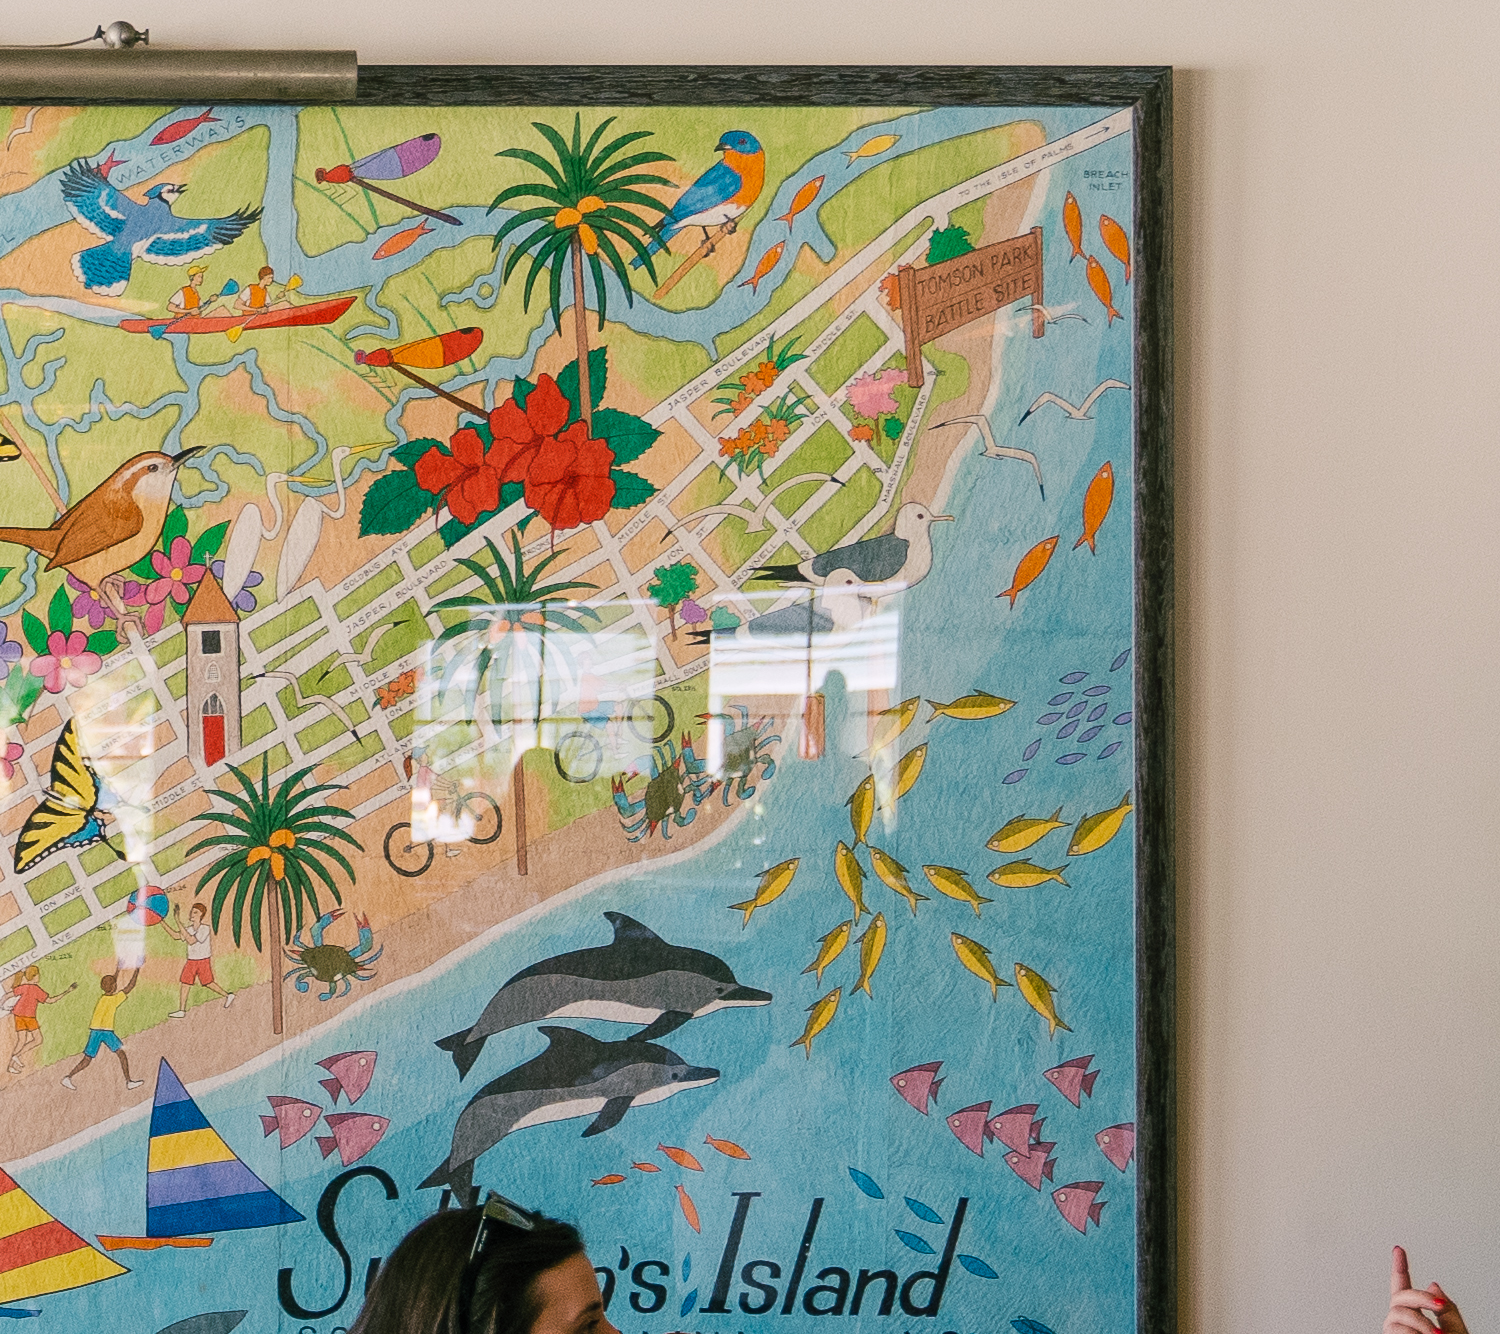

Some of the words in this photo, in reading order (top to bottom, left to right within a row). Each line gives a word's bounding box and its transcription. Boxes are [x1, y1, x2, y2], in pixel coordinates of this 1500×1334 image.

[114, 114, 248, 185] WATERWAYS
[957, 188, 970, 198] TO
[973, 178, 992, 190] THE
[997, 167, 1019, 181] ISLE
[1023, 158, 1037, 169] OF
[1040, 142, 1074, 161] PALMS
[1083, 169, 1129, 179] BREACH
[1089, 182, 1123, 191] INLET
[917, 262, 985, 298] TOMSON
[990, 241, 1033, 270] PARK
[923, 291, 985, 335] BATTLE
[994, 272, 1033, 304] SITE
[811, 325, 842, 356] MIDDLE
[666, 378, 709, 413] JASPER
[713, 331, 774, 378] BOULEVARD
[810, 409, 828, 428] ION
[881, 453, 906, 505] MARSHALL
[903, 393, 927, 448] BOULEVARD
[616, 509, 652, 544] MIDDLE
[666, 545, 685, 562] ION
[730, 541, 779, 588] BROWNELL
[341, 561, 382, 593] GOLDBUG
[394, 559, 448, 600] BOULEVARD
[103, 648, 135, 671] RAVEN
[349, 671, 391, 698] MIDDLE
[384, 706, 404, 721] ION
[151, 785, 187, 811] MIDDLE
[38, 898, 57, 915] ION
[699, 1190, 970, 1320] Island
